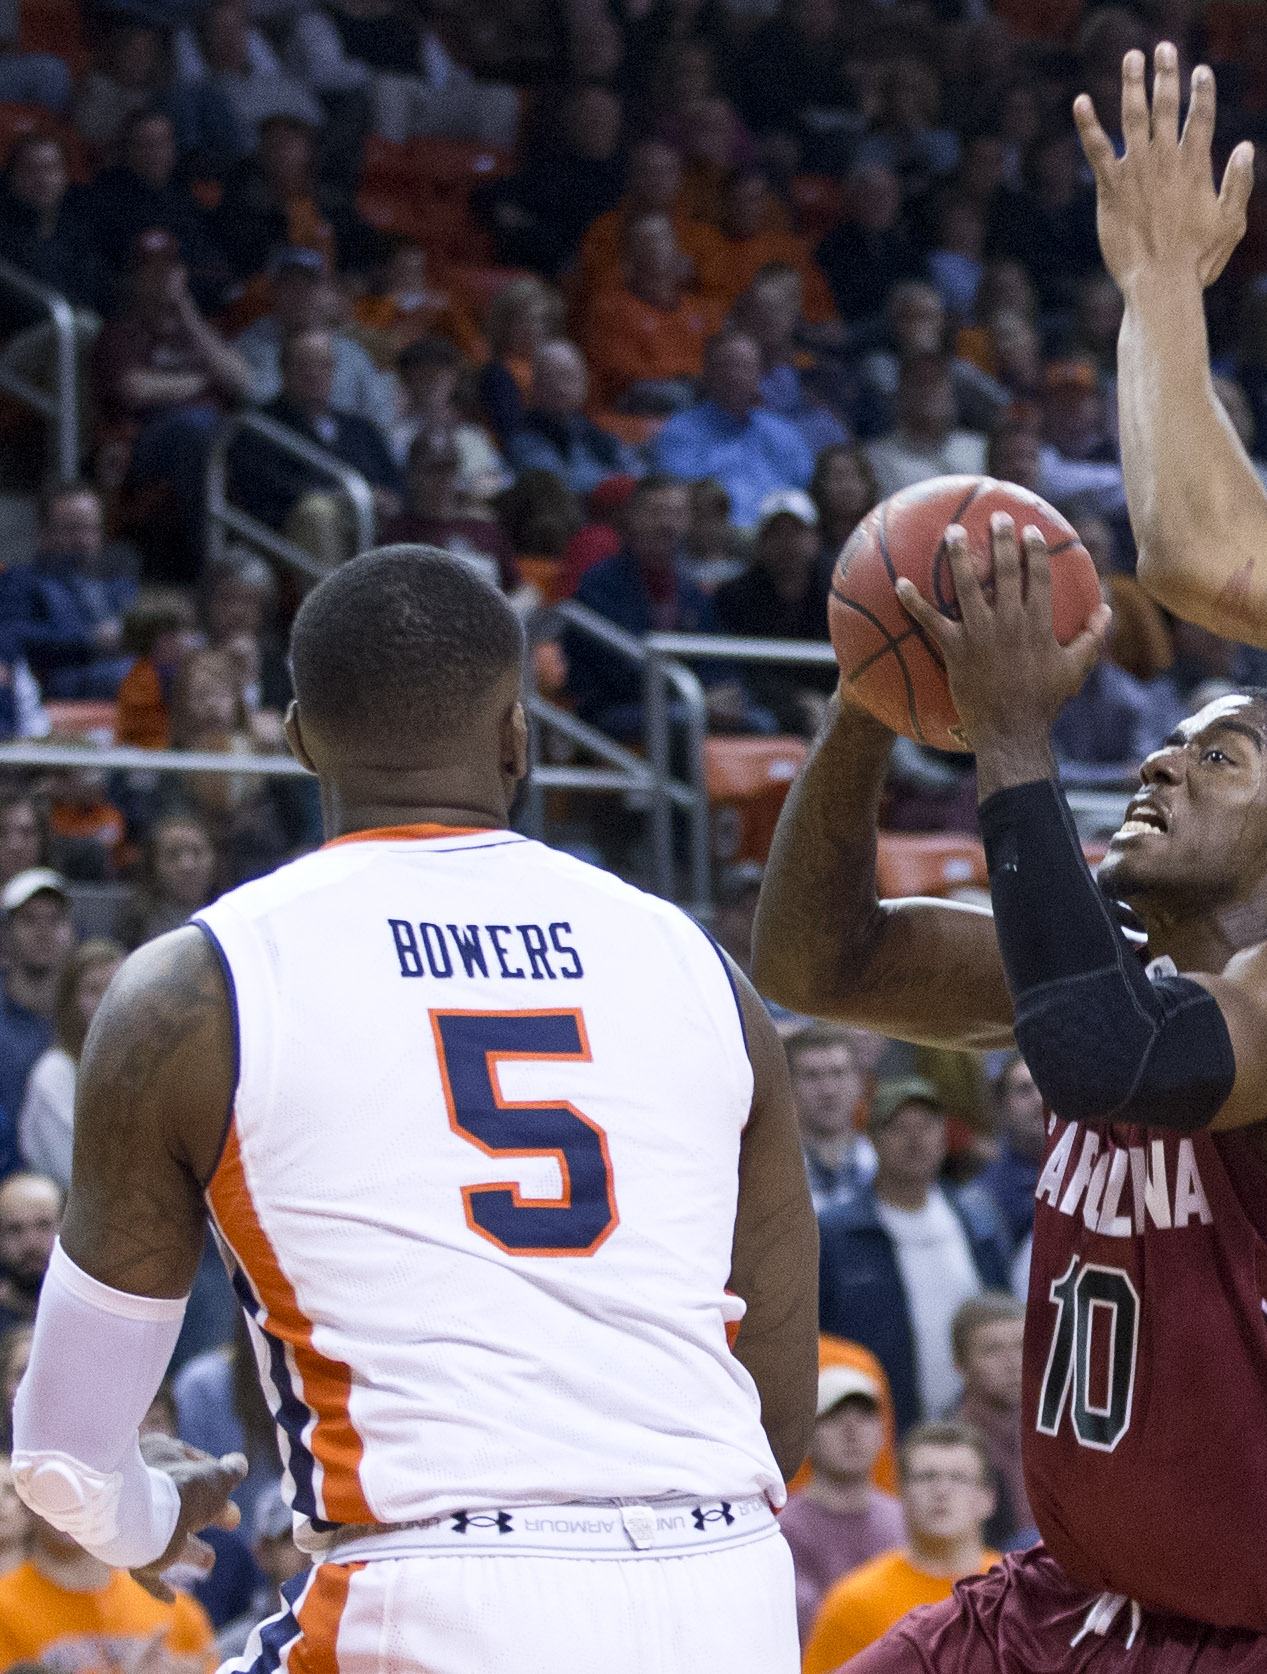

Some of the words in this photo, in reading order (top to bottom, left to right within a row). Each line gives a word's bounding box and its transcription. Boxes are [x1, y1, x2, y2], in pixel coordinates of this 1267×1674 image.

[387, 918, 584, 979] BOWERS
[428, 1007, 620, 1257] 5
[1035, 1111, 1213, 1237] AROLINA
[1036, 1254, 1140, 1452] 10
[525, 1519, 614, 1533] ARMOUR
